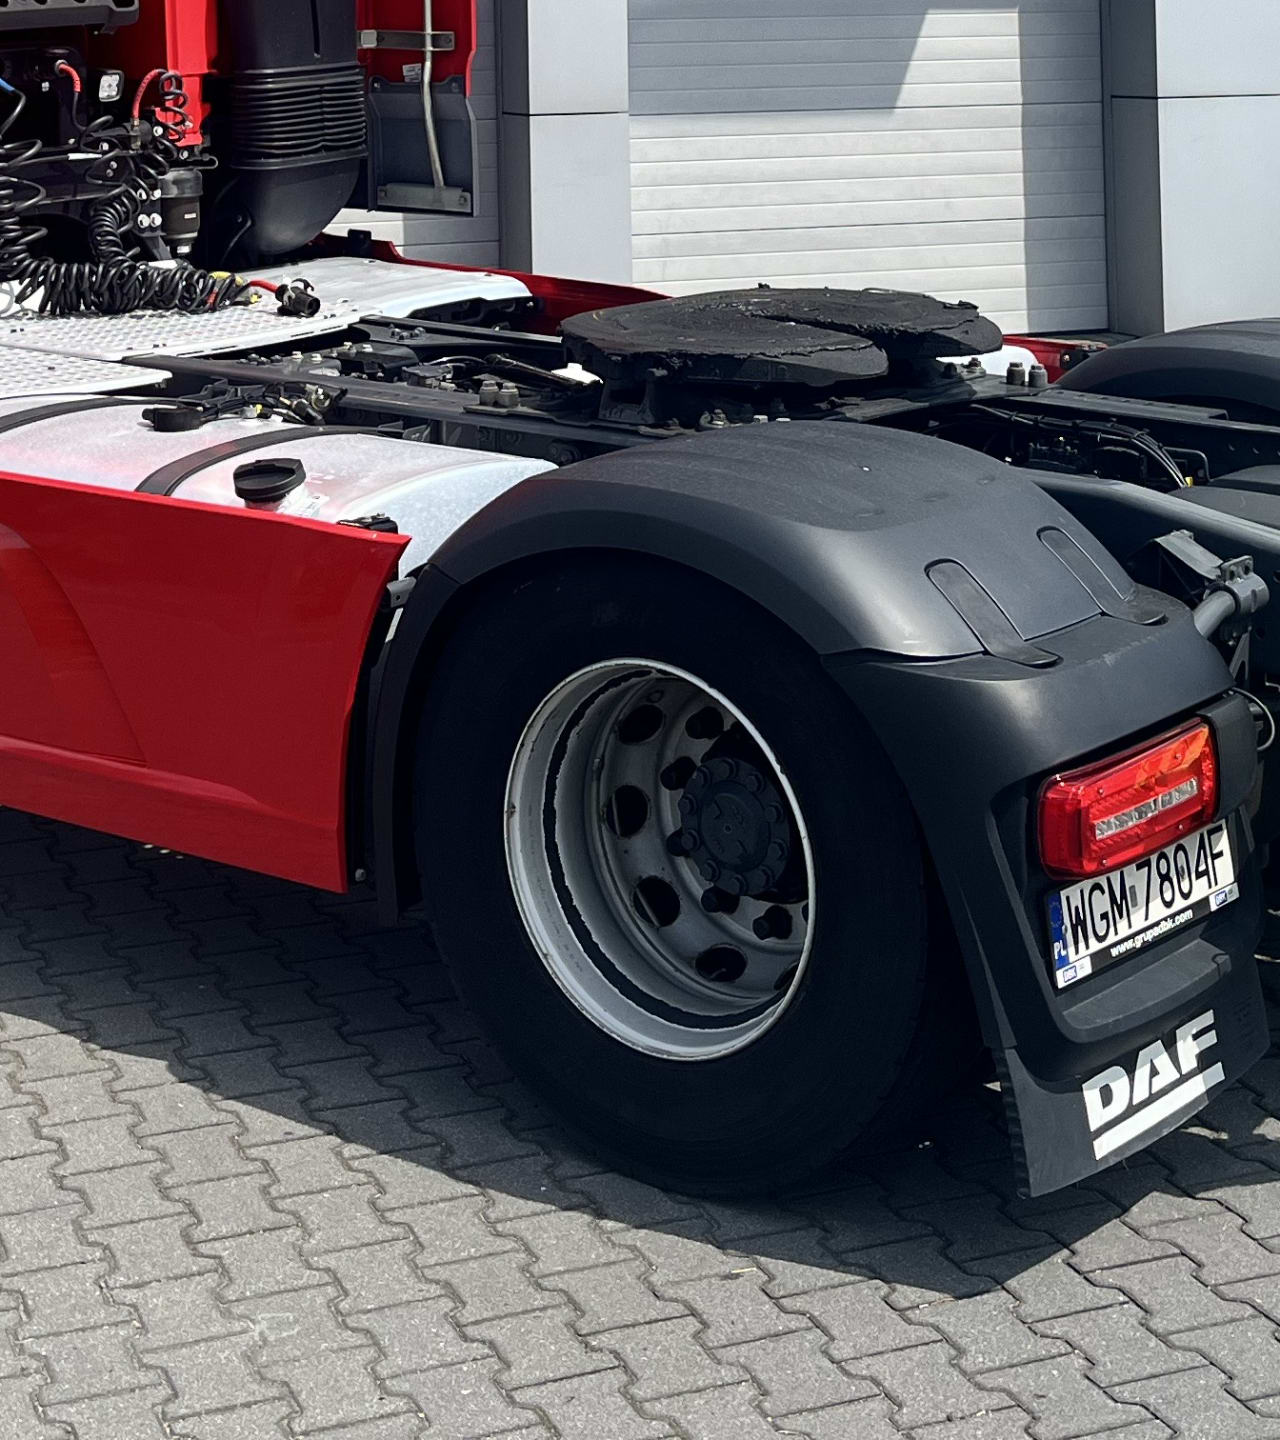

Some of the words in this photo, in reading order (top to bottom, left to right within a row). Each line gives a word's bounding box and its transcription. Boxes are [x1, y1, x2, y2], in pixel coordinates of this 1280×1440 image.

[1066, 869, 1132, 956] WGM
[1136, 824, 1224, 922] 7804F
[1053, 939, 1067, 960] PL
[1110, 909, 1193, 958] www.grupadbk.com
[1082, 1009, 1217, 1132] DAF
